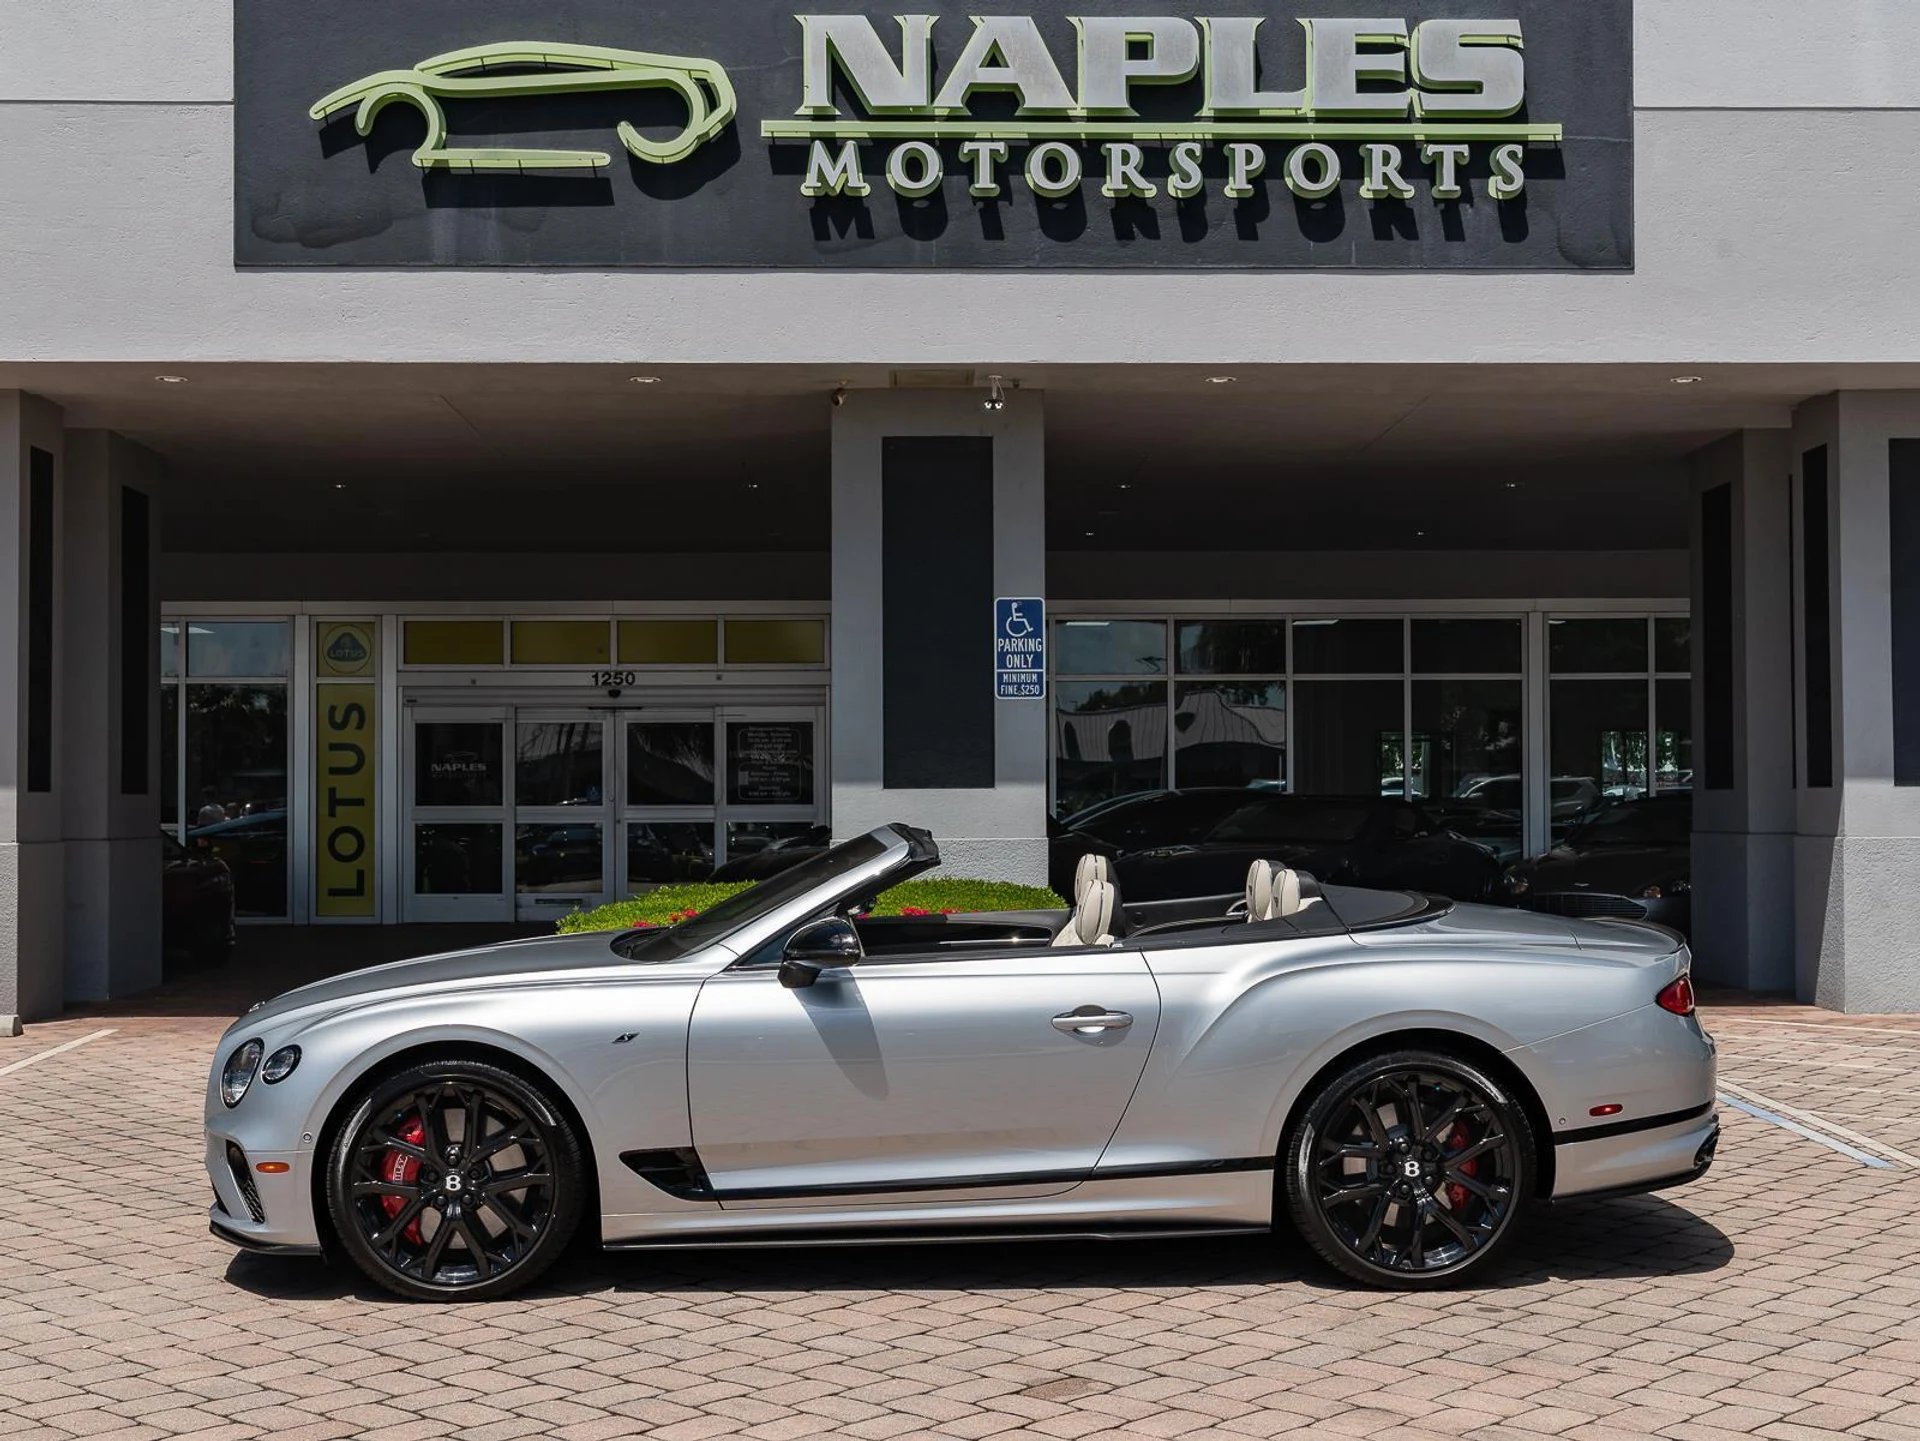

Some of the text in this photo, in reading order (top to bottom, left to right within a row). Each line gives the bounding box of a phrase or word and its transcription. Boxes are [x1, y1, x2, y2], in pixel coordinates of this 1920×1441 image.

[794, 15, 1524, 118] NAPLES
[800, 140, 1525, 199] MOTORSPORTS
[998, 638, 1042, 652] PARKING
[329, 648, 365, 659] LOTUS
[1006, 654, 1034, 668] ONLY
[591, 671, 636, 686] 1250
[1003, 673, 1038, 683] MINIMUM
[1000, 684, 1040, 696] FINE $250
[431, 762, 487, 772] NAPLES
[328, 702, 366, 897] LOTUS
